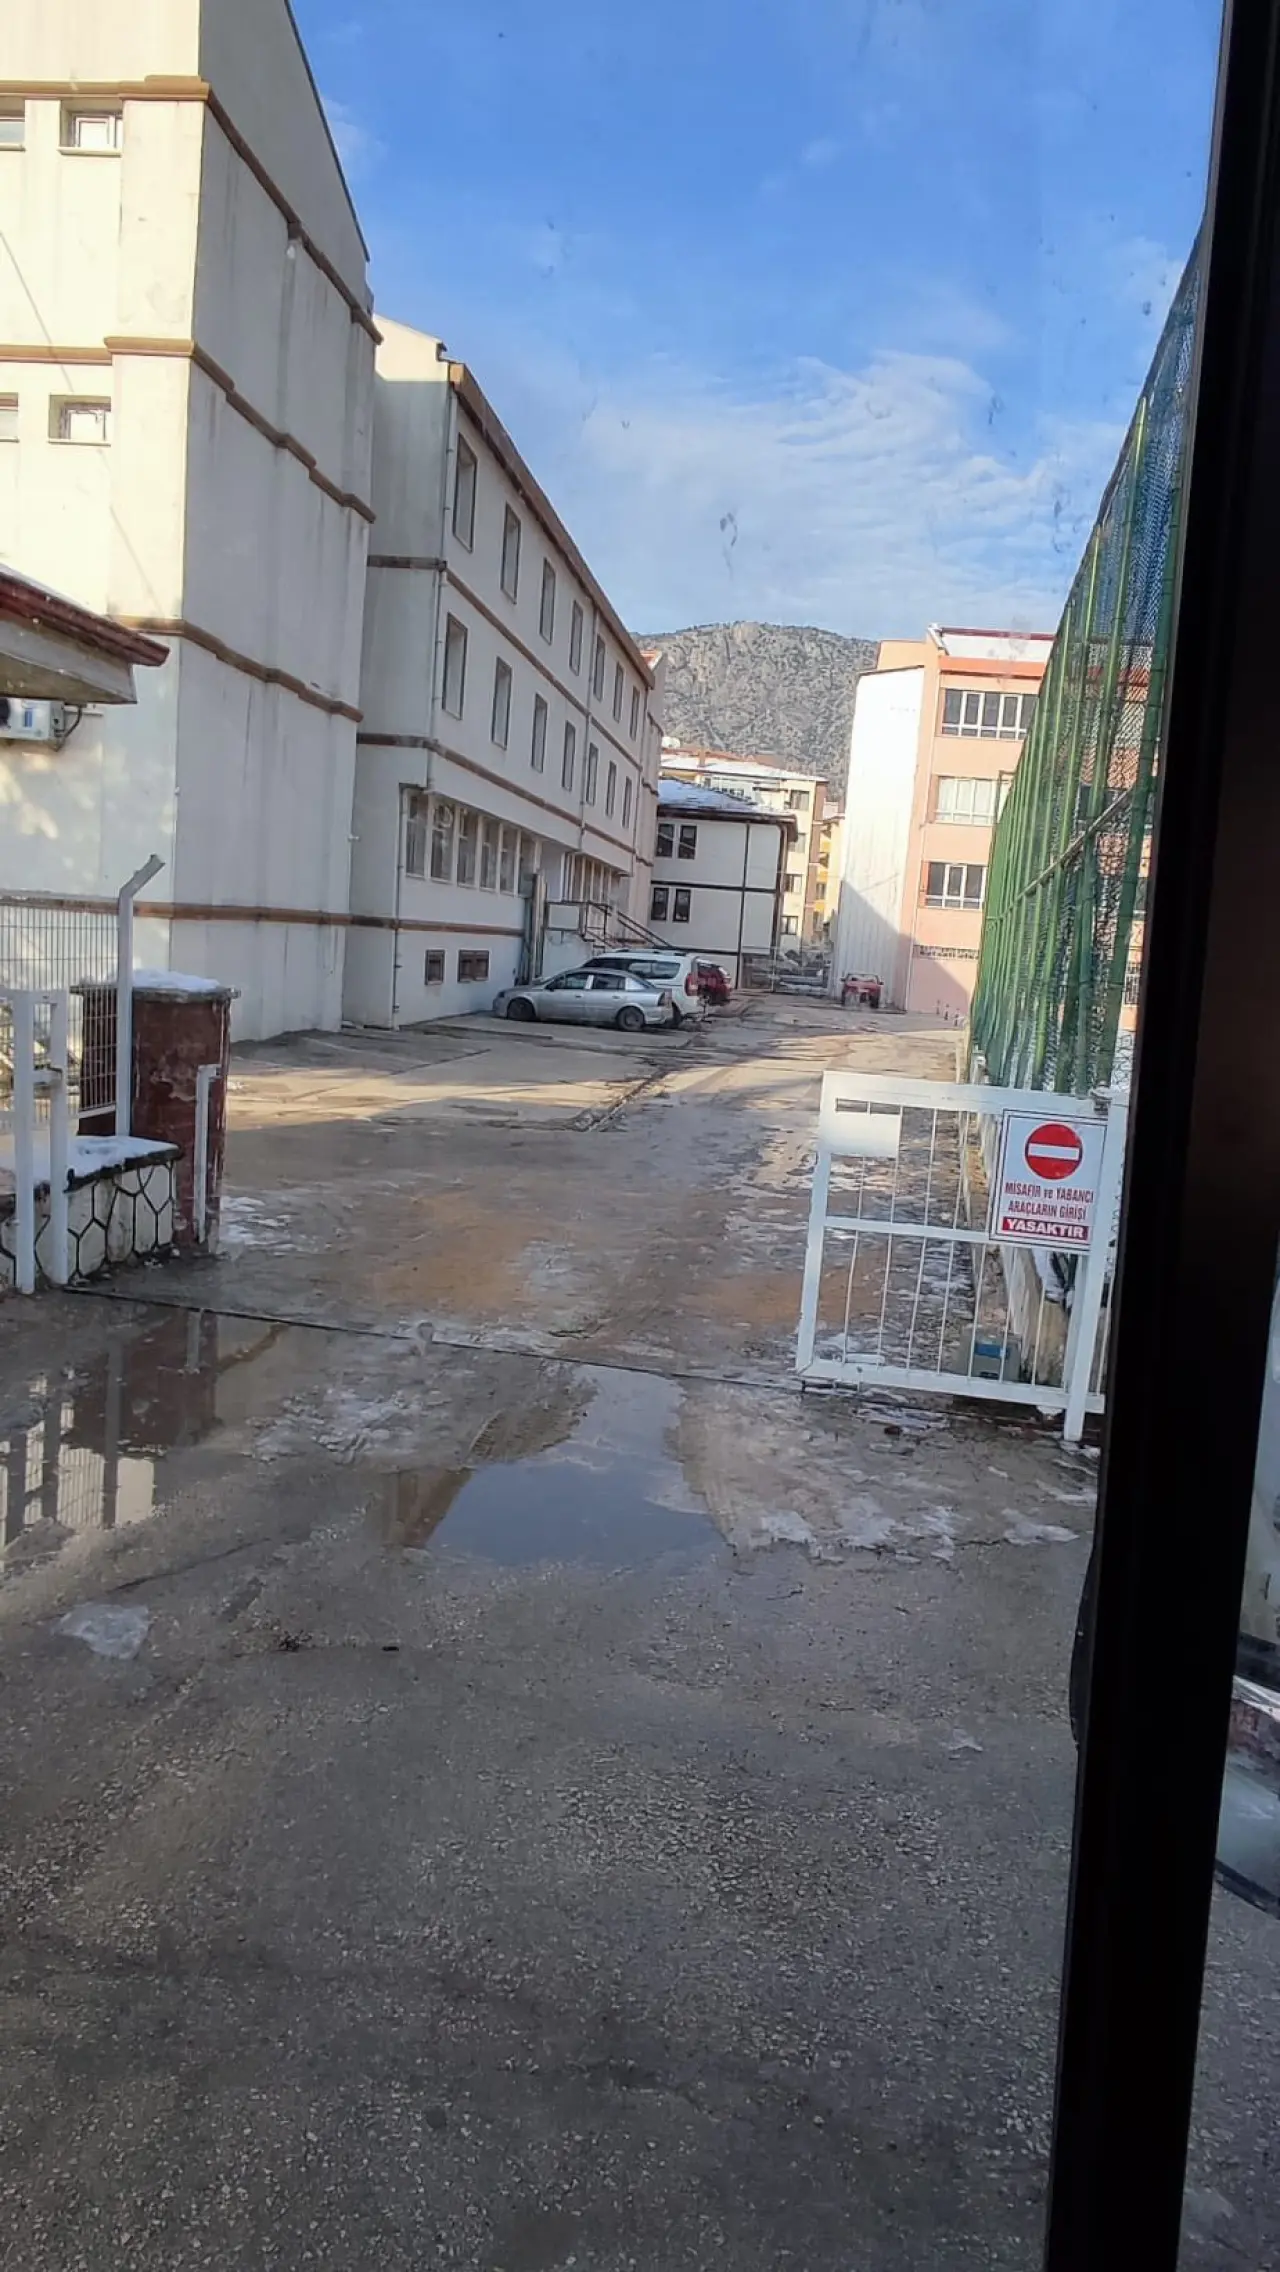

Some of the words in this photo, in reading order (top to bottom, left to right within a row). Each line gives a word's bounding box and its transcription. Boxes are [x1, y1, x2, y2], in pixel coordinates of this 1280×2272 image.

[1044, 1189, 1053, 1199] ve
[1056, 1188, 1094, 1203] YABANCI
[1007, 1219, 1084, 1238] YASAKTIR
